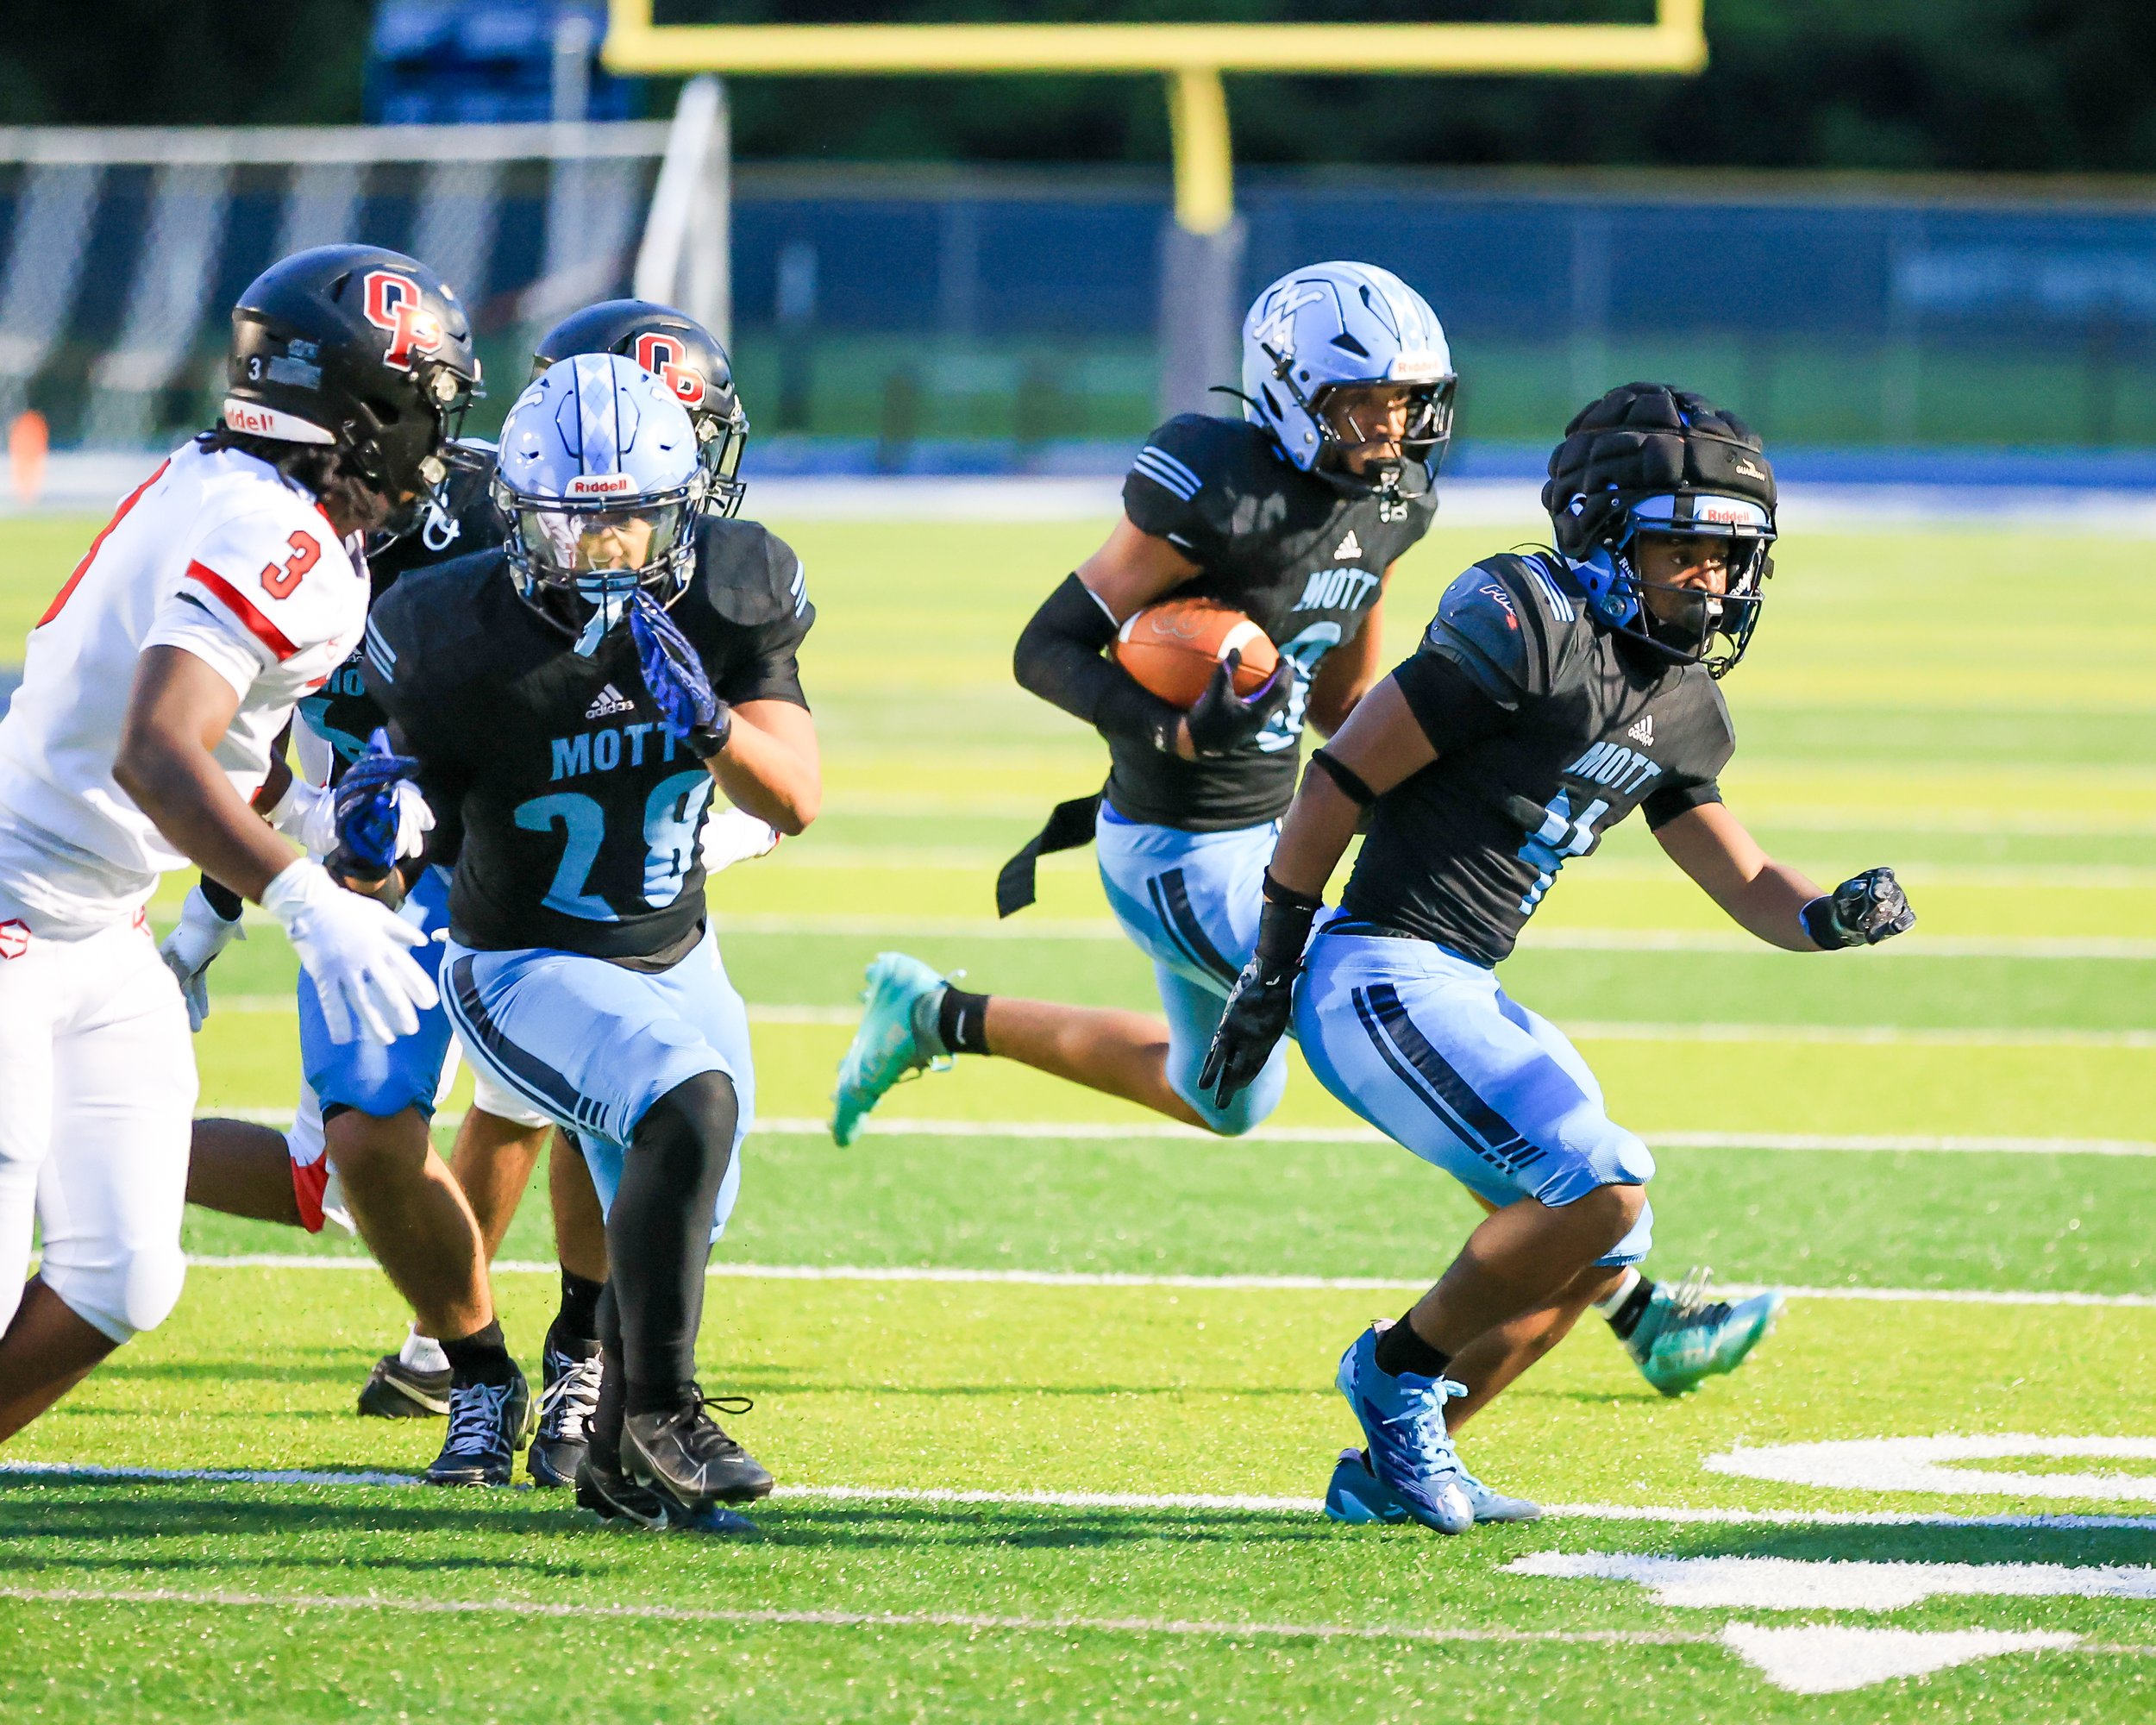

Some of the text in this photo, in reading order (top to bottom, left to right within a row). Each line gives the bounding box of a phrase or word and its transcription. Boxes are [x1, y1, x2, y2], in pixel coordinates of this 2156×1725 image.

[248, 357, 260, 380] 3
[574, 479, 628, 493] Riddell
[1708, 509, 1751, 523] Riddell
[260, 530, 322, 600] 3
[1291, 567, 1380, 612] MOTT
[585, 699, 636, 720] adidas
[549, 721, 678, 782] MOTT
[1562, 741, 1663, 795] MOTT
[513, 769, 714, 923] 28
